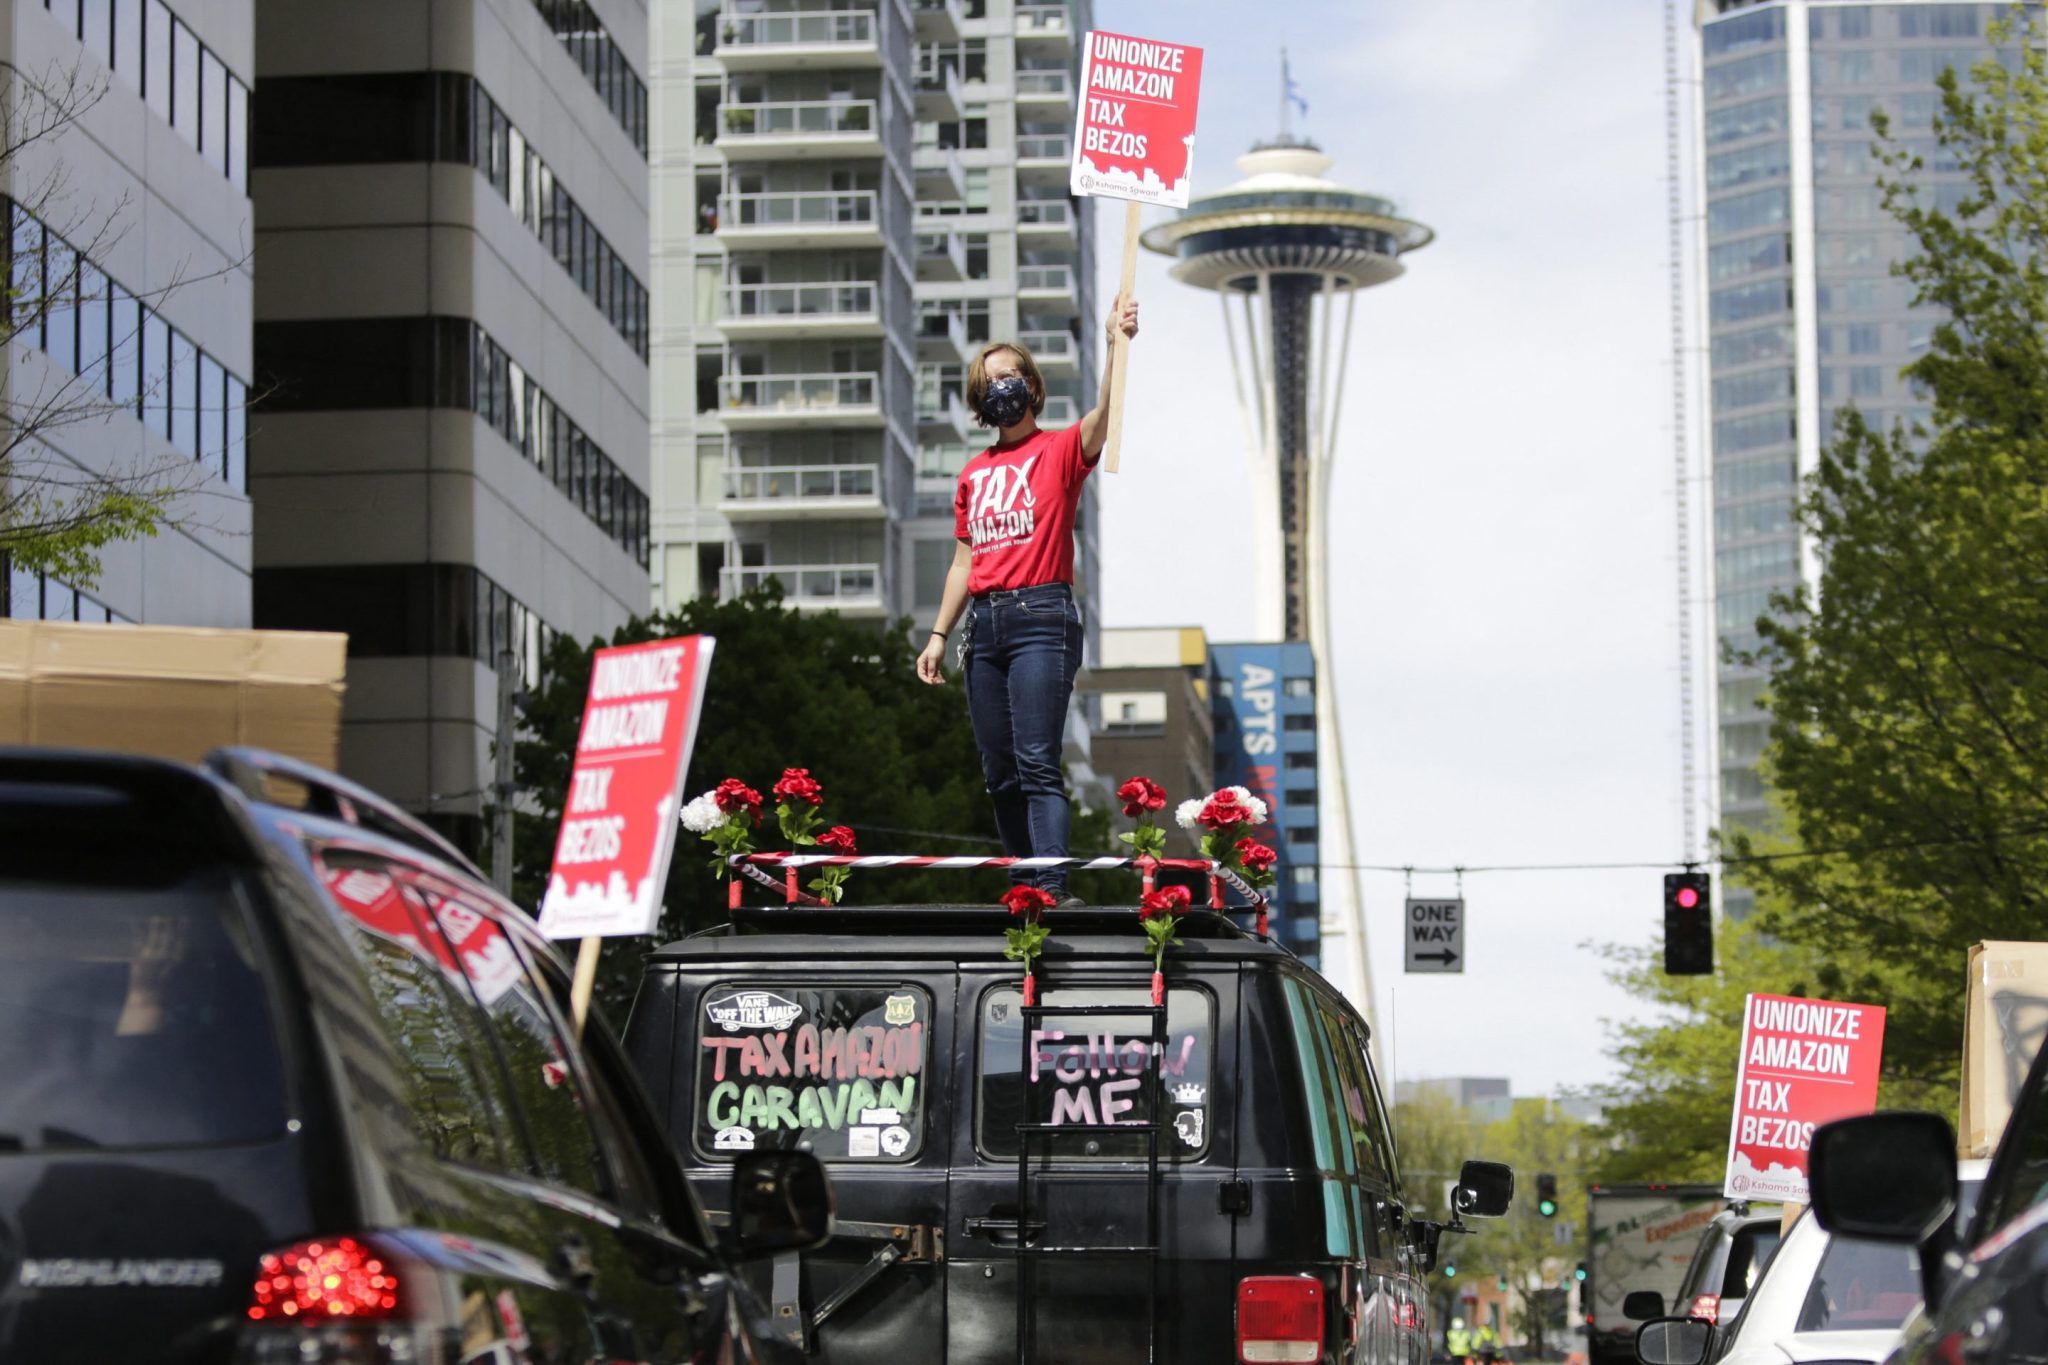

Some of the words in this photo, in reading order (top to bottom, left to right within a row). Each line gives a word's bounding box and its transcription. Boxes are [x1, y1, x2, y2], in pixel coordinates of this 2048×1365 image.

[1094, 35, 1184, 72] UNIONIZE
[1091, 64, 1174, 100] AMAZON
[1089, 98, 1126, 127] TAX
[1085, 127, 1148, 159] BEZOS
[1096, 181, 1128, 192] Kshama
[1129, 186, 1159, 197] Sawant
[969, 456, 1036, 521] TAX
[592, 646, 685, 701] UNIONIZE
[579, 699, 670, 751] AMAZON
[1241, 662, 1277, 756] APTS
[571, 766, 615, 813] TAX
[556, 815, 625, 865] BEZOS
[1412, 905, 1457, 922] ONE
[1412, 926, 1458, 943] WAY
[735, 995, 769, 1007] VANS
[738, 1006, 763, 1023] THE
[1753, 998, 1862, 1040] UNIONIZE
[701, 1032, 791, 1082] TAX
[794, 1021, 922, 1080] AMAZON
[1748, 1035, 1849, 1075] AMAZON
[707, 1076, 915, 1131] CARAVAN
[1051, 1078, 1149, 1127] ME
[1746, 1079, 1791, 1113] TAX
[1740, 1115, 1816, 1152] BEZOS
[1751, 1181, 1790, 1193] Kshama
